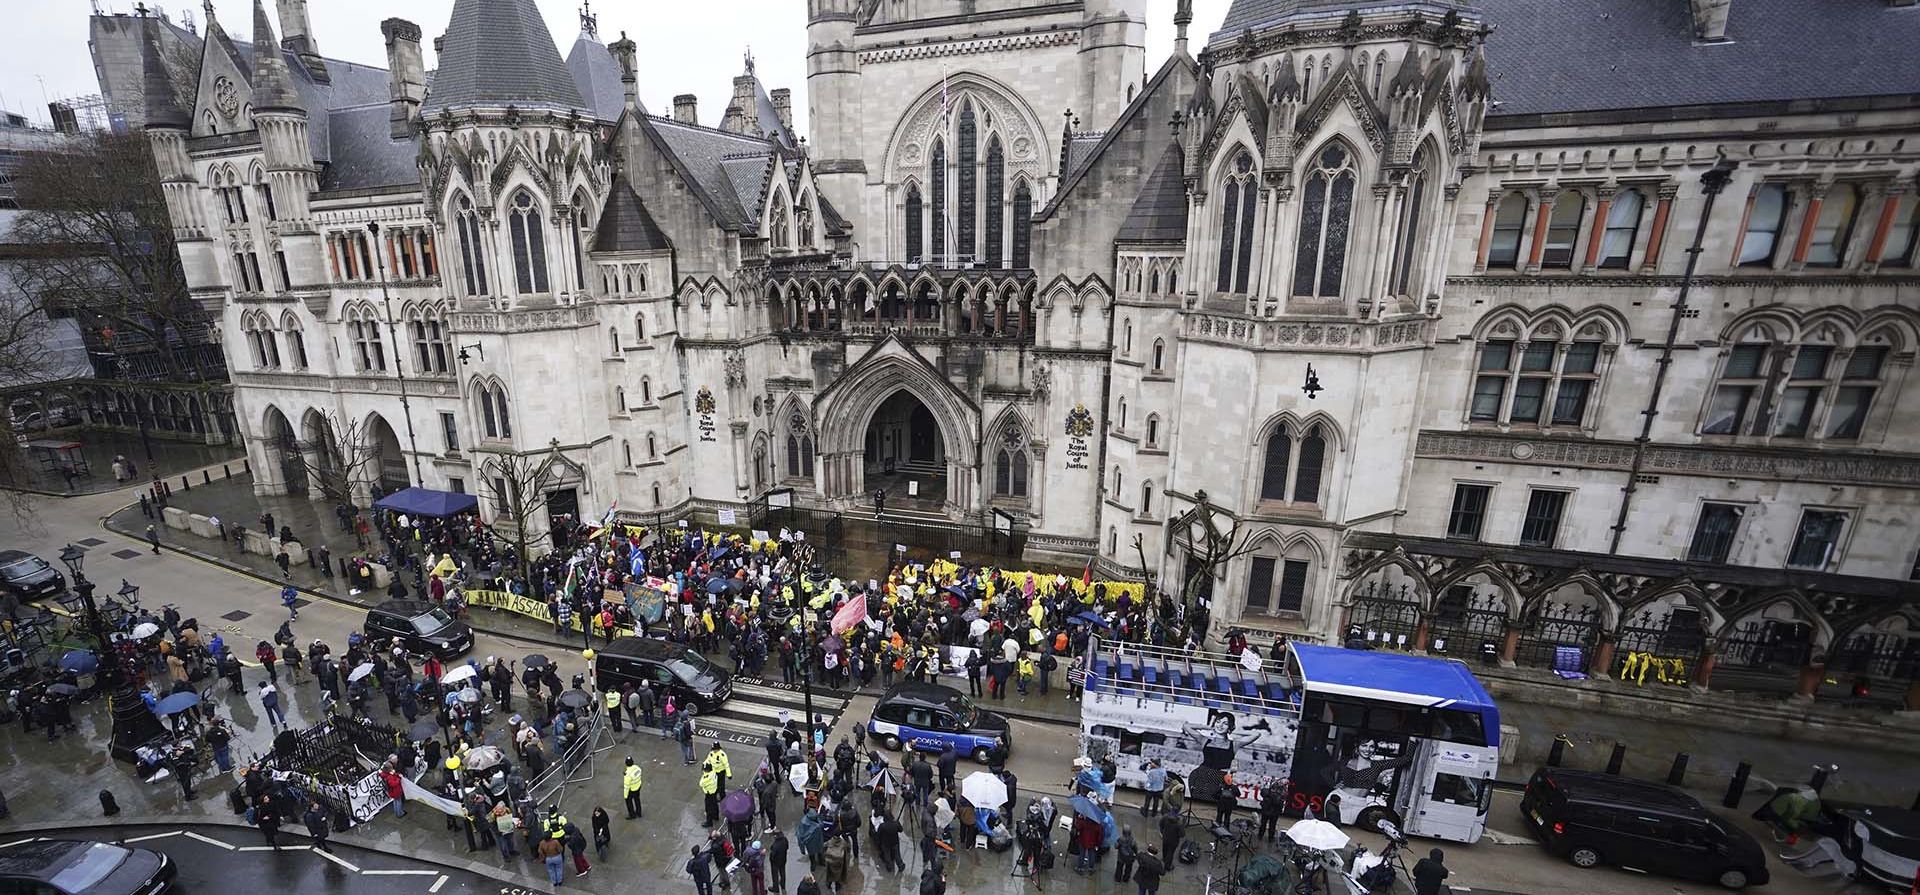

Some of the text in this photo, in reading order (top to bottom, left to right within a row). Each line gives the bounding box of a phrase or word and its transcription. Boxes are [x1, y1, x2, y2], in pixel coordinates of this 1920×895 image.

[1069, 443, 1087, 451] Royal
[512, 594, 554, 620] ASSAN
[770, 681, 801, 691] LOOK
[698, 728, 761, 745] OOK LEFT
